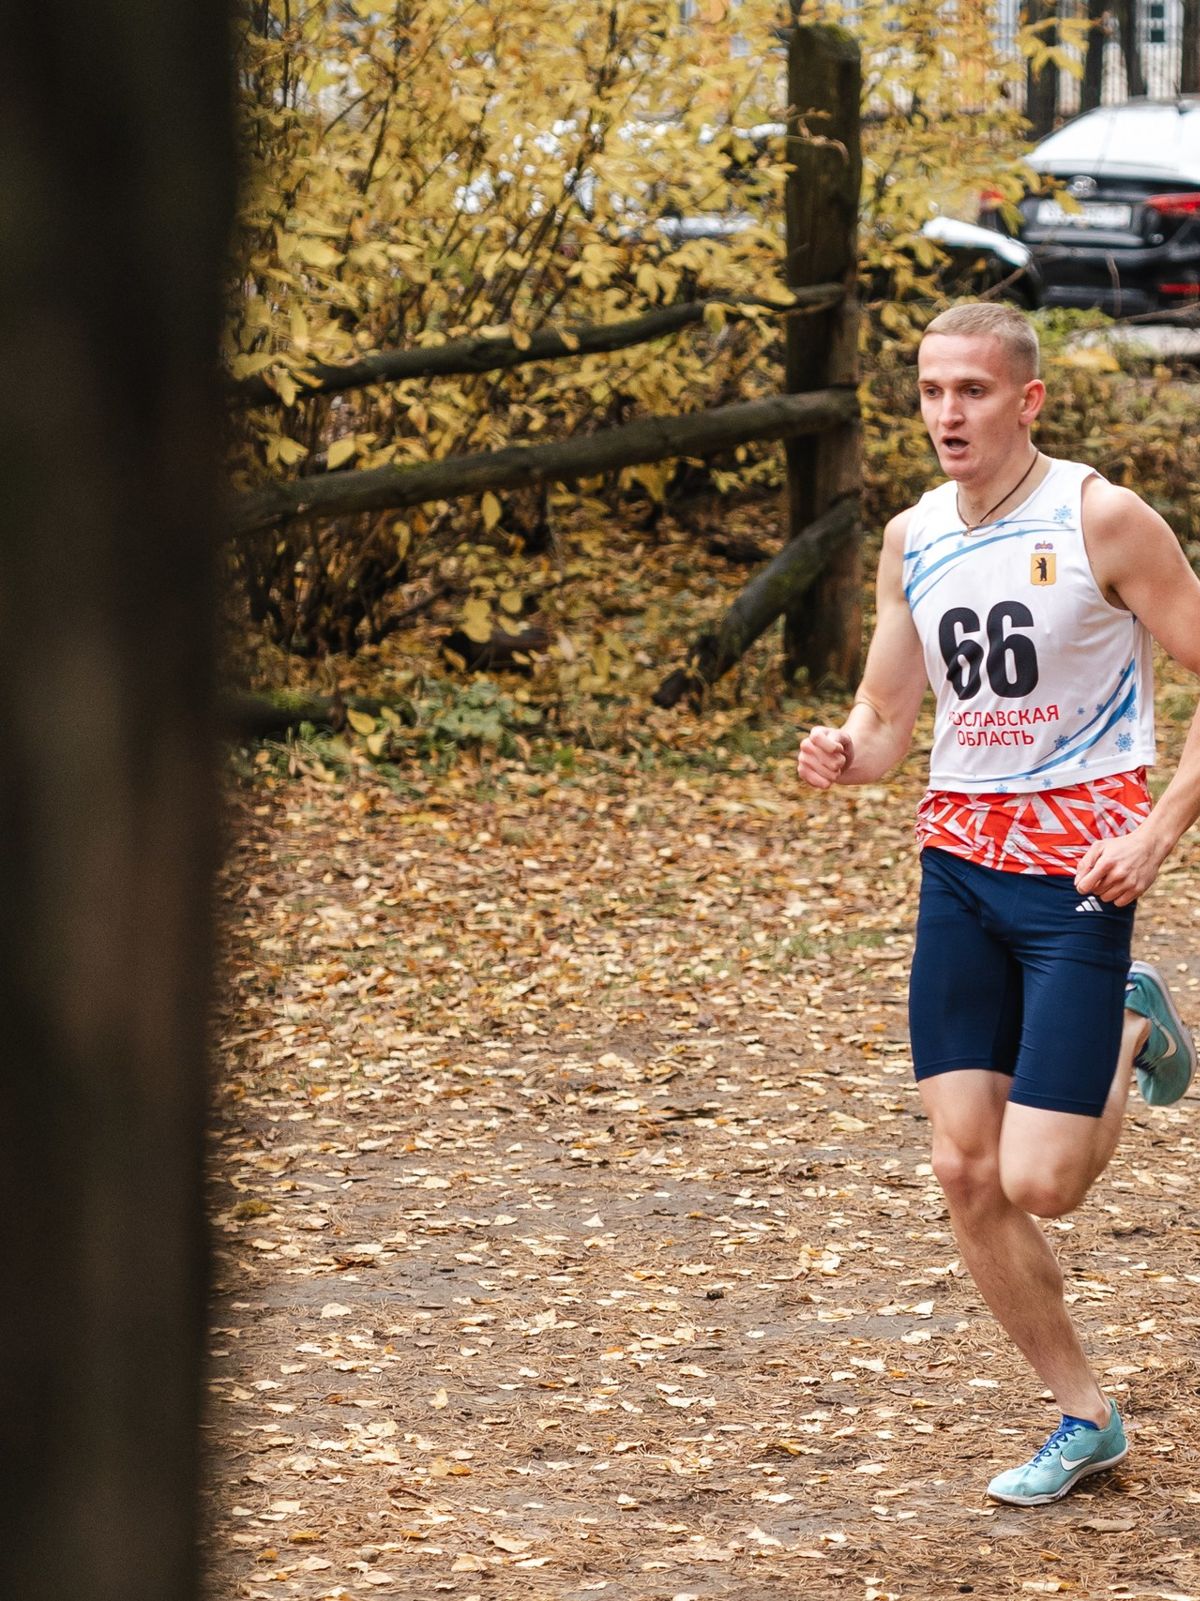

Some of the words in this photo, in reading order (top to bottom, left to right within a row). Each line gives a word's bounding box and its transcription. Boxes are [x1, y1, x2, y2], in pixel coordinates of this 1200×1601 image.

[938, 600, 1039, 701] 66
[949, 704, 1060, 727] ОСЛАВСКАЯ
[957, 730, 1035, 747] ОБЛАСТЬ
